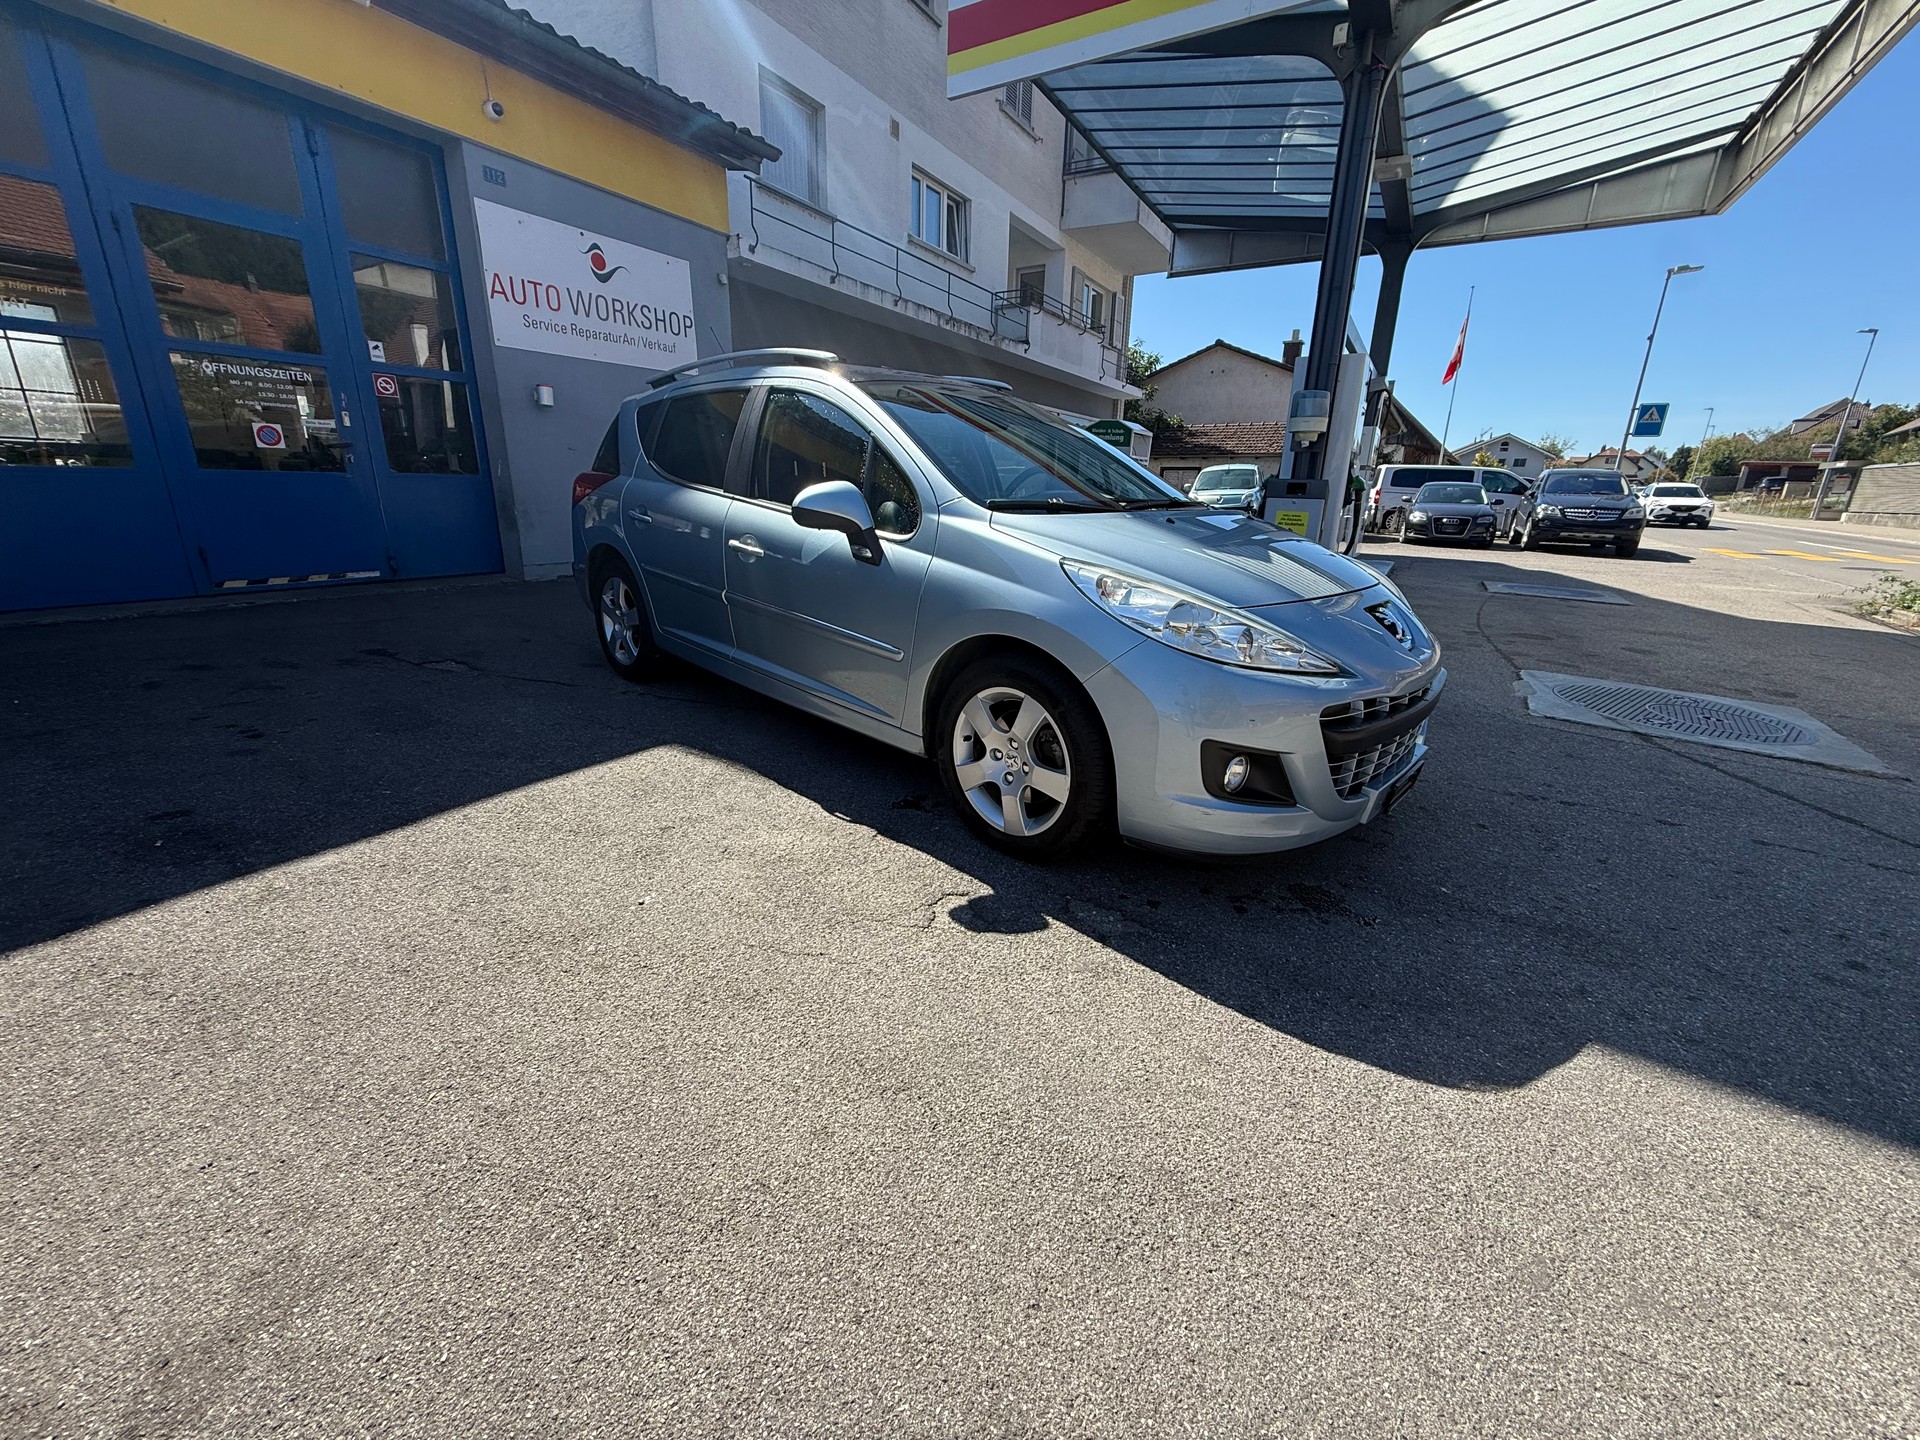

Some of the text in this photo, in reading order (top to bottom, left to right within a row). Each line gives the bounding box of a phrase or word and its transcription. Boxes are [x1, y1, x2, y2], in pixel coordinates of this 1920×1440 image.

[9, 281, 33, 291] hier
[36, 286, 67, 296] nicht
[490, 272, 694, 338] AUTO WORKSHOP
[522, 314, 677, 354] Service ReparaturAn/Verkauf
[202, 360, 312, 381] ÖFFNUNGSZEITEN
